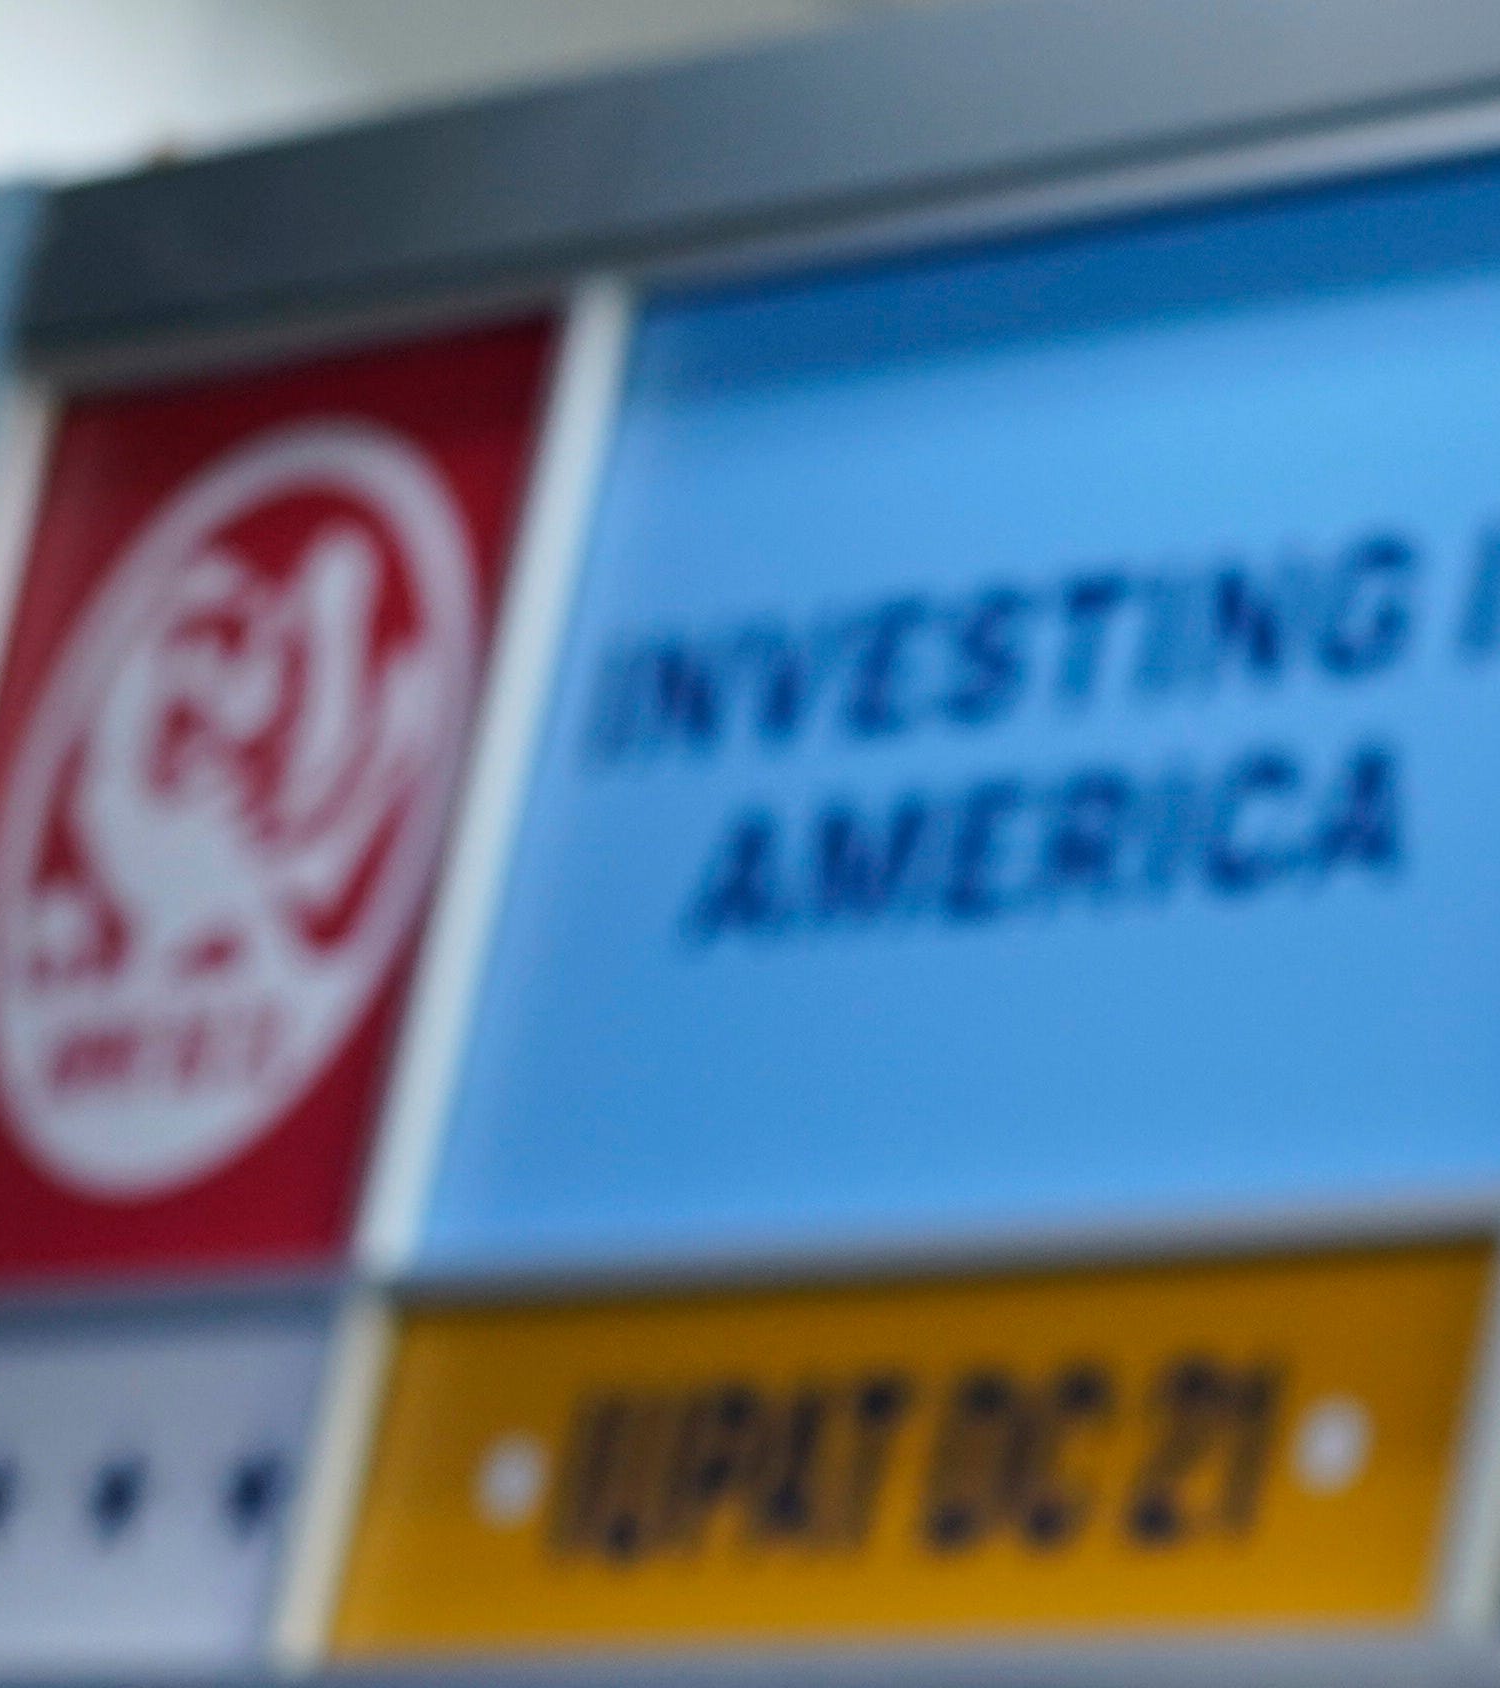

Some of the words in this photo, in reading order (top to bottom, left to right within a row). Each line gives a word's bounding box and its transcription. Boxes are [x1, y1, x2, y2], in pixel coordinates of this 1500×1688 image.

[576, 530, 1422, 772] INVESTING
[680, 738, 1406, 950] AMERICA
[920, 1356, 1114, 1556] DC
[1124, 1346, 1286, 1552] 21
